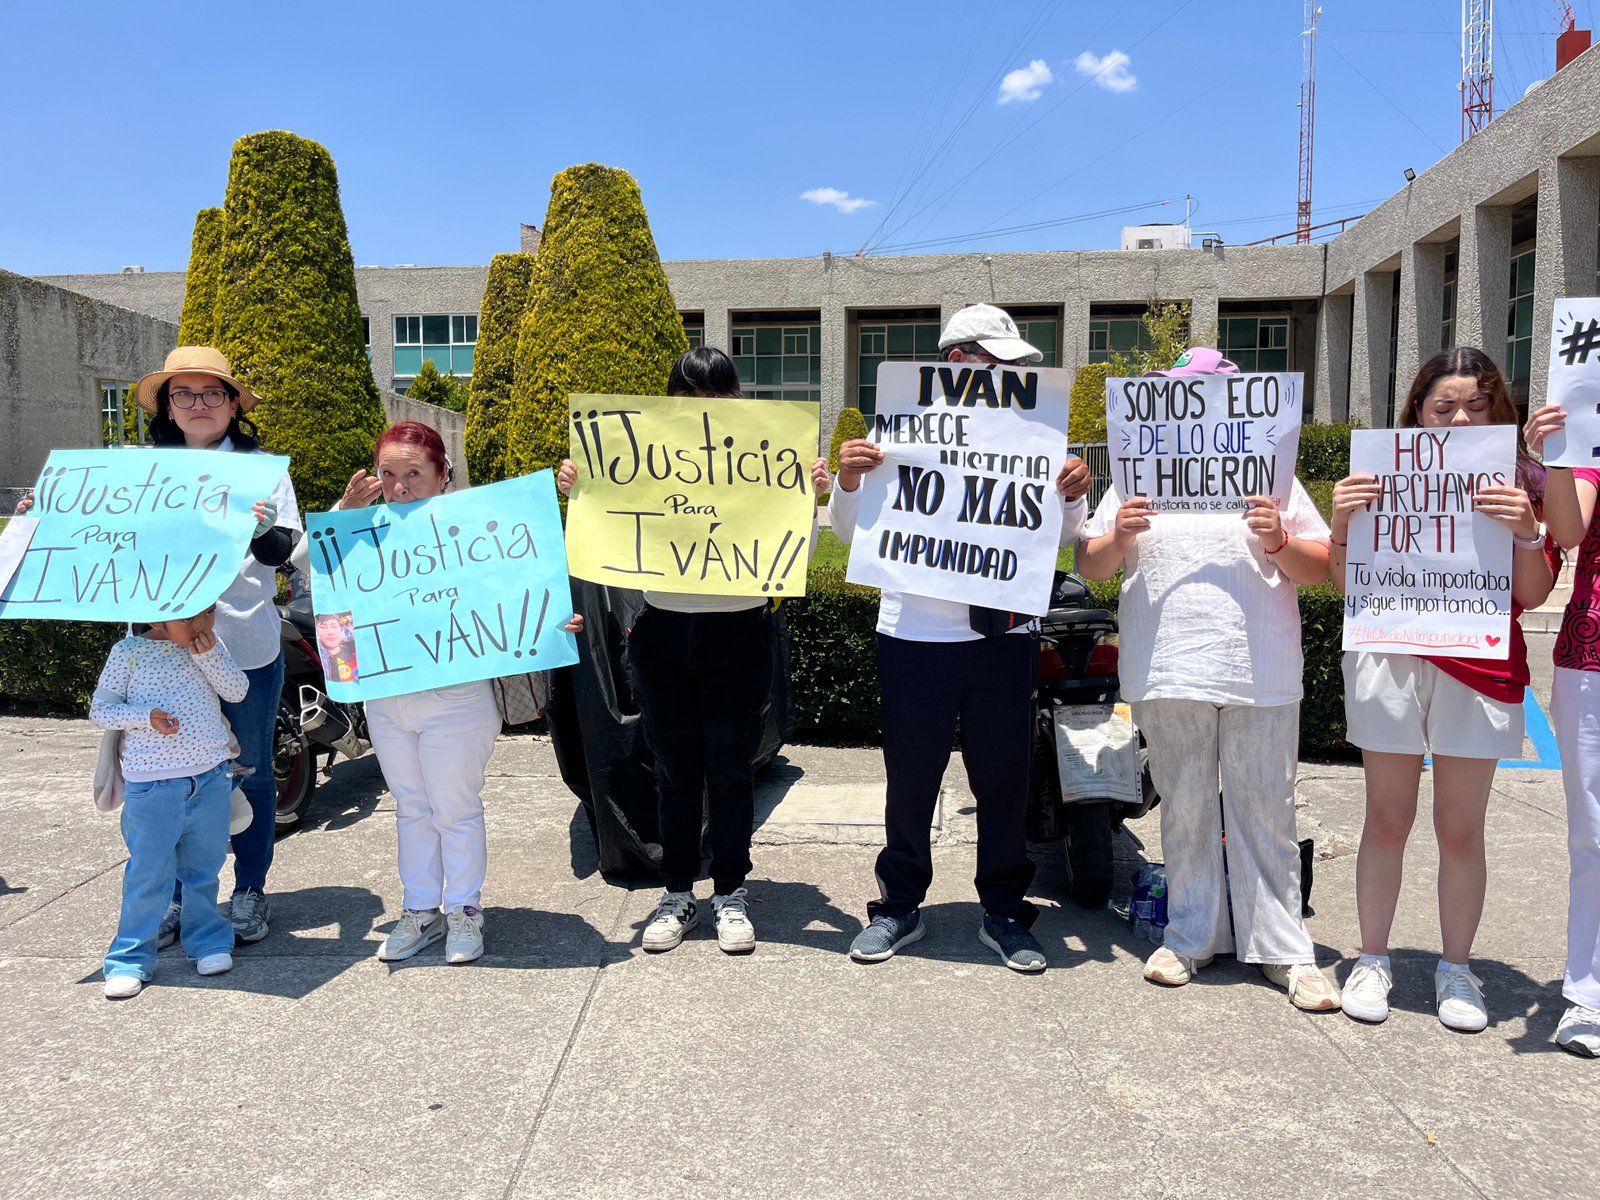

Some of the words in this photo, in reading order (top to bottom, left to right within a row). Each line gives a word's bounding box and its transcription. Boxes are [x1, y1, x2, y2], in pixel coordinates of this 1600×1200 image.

[916, 364, 1038, 411] IVÁN
[1122, 380, 1206, 422] SOMOS
[1226, 375, 1280, 419] ECO
[874, 412, 970, 448] MERECE
[1138, 423, 1169, 456] DE
[1176, 422, 1205, 455] LO
[1213, 420, 1255, 454] QUE
[1394, 430, 1451, 472] HOY
[1117, 456, 1148, 498] TE
[1155, 454, 1277, 498] HICIERON
[664, 493, 718, 518] Para
[890, 464, 946, 517] NO
[956, 475, 1046, 532] MAS
[1151, 498, 1191, 511] historia
[1193, 501, 1208, 511] no
[1209, 501, 1222, 511] se
[1225, 499, 1250, 511] calla
[71, 524, 137, 551] Para
[1373, 514, 1422, 554] POR
[1429, 514, 1455, 554] TI
[878, 529, 1018, 582] IMPUNIDAD
[1347, 562, 1371, 586] Tu
[1375, 565, 1416, 588] vida
[1422, 568, 1511, 593] importaba
[392, 585, 459, 607] Para
[1347, 594, 1356, 618] y
[1360, 592, 1397, 617] sigue
[1400, 593, 1512, 616] importando...
